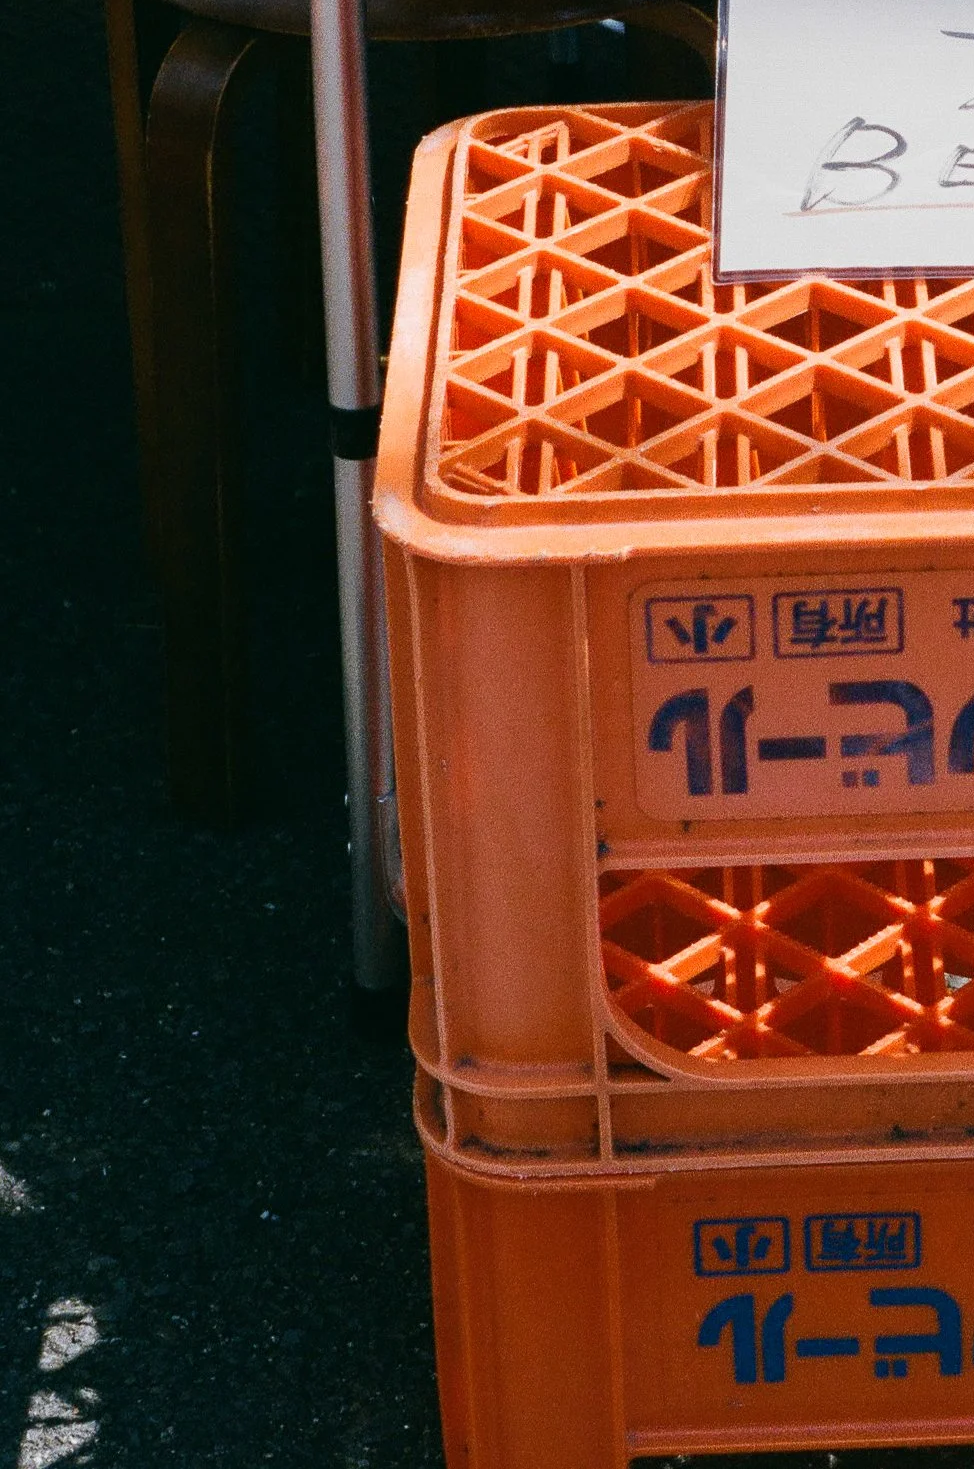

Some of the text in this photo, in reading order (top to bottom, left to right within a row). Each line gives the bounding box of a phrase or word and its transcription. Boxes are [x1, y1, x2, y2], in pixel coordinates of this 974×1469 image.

[663, 602, 736, 653] 小
[789, 596, 887, 647] 所有
[712, 1225, 770, 1265] 小
[817, 1219, 908, 1264] 所有
